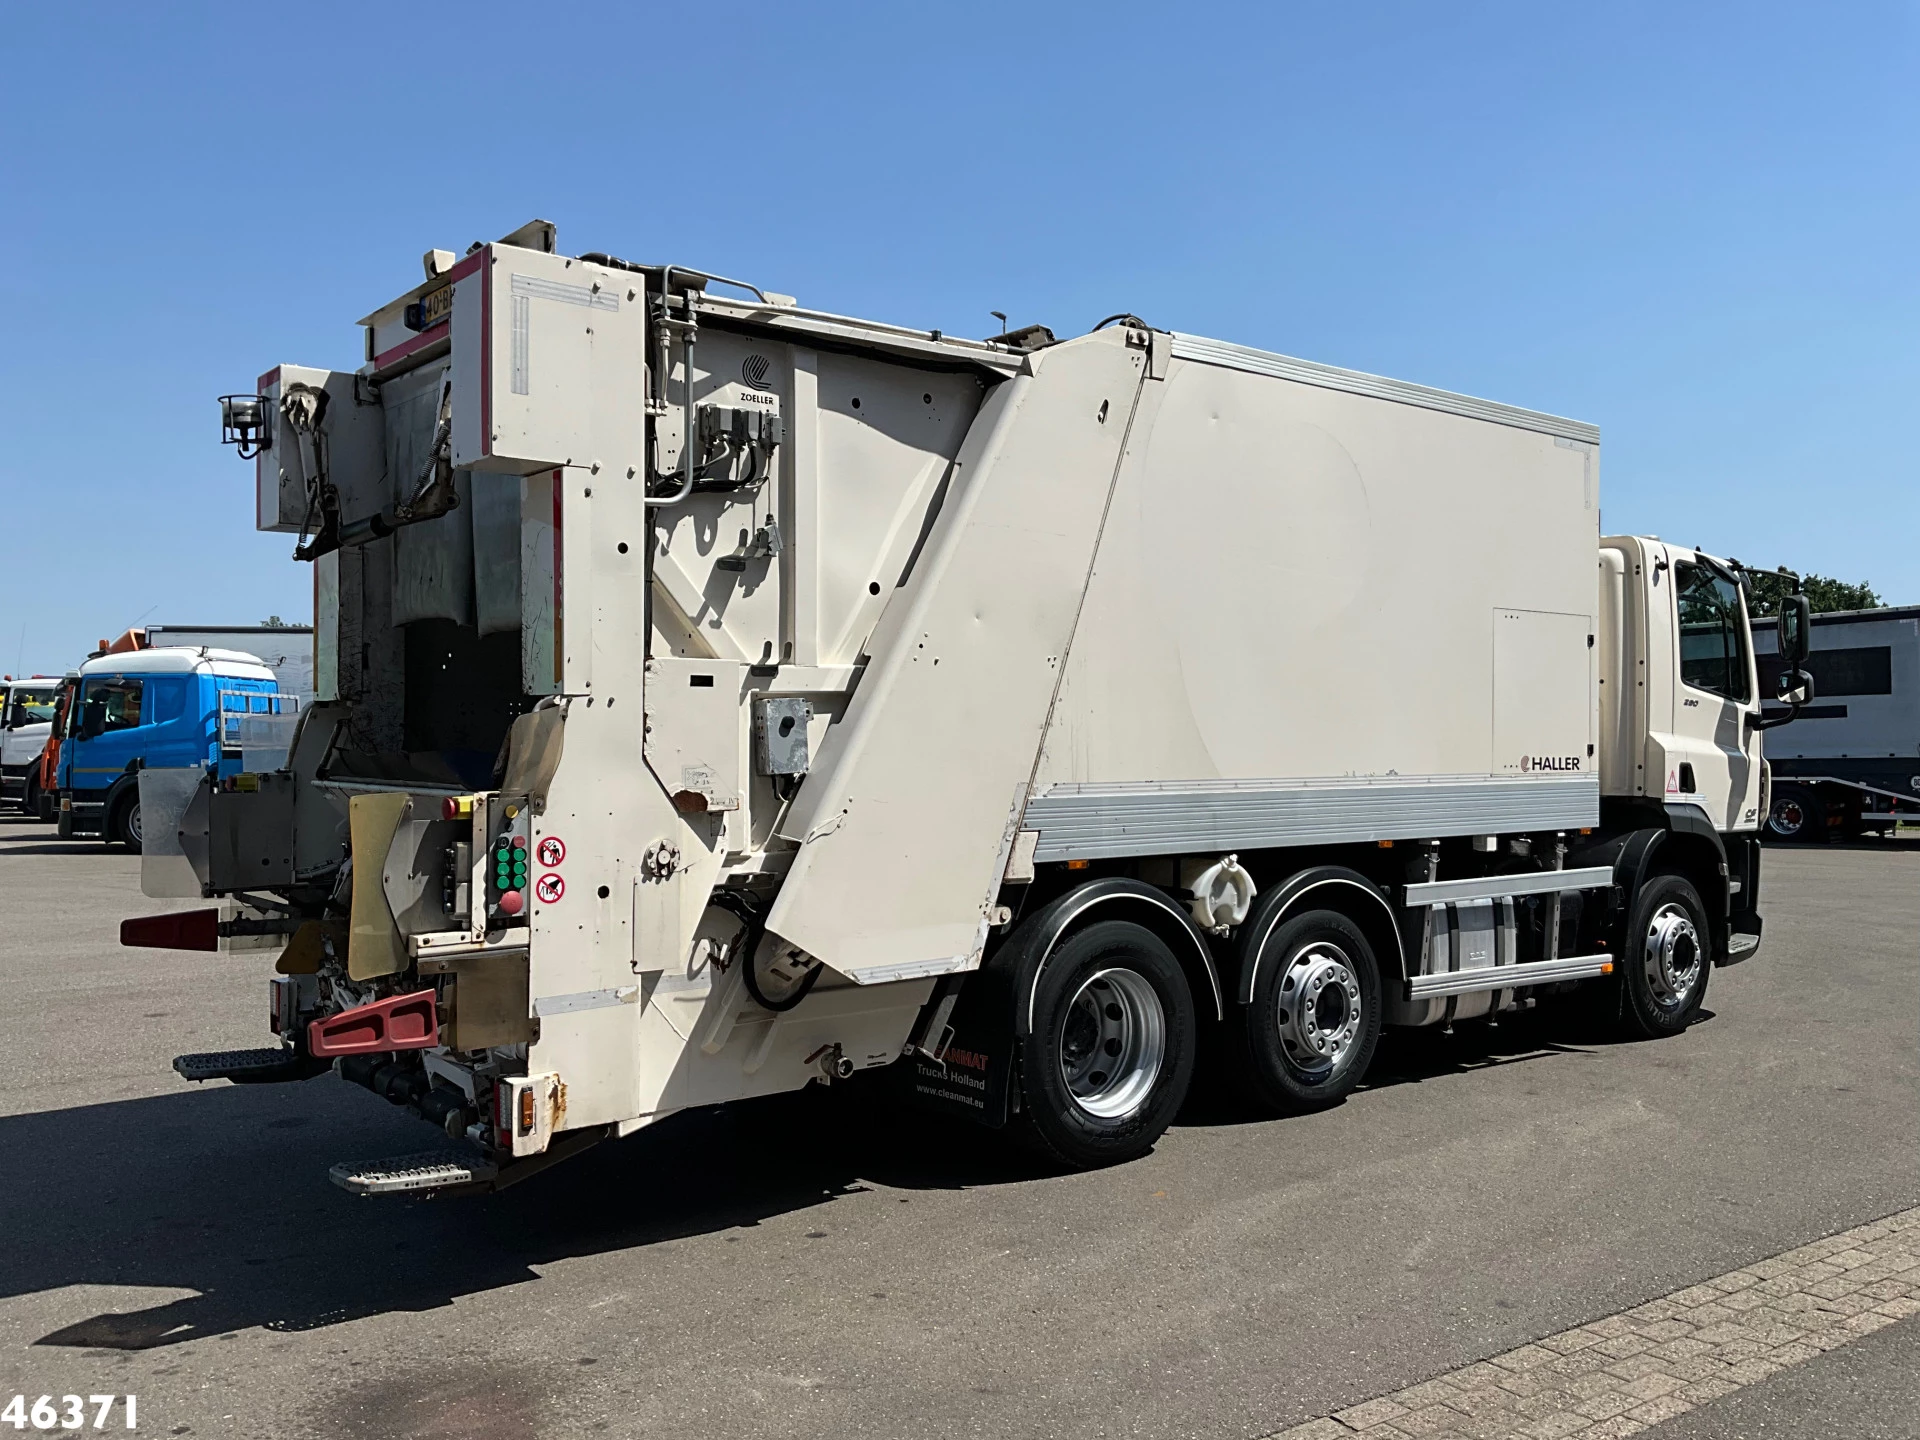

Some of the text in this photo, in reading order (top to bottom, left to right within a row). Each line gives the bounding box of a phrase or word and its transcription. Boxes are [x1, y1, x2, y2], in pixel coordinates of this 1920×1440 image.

[426, 289, 452, 317] 40-B
[740, 392, 774, 405] ZOELLER
[1532, 756, 1580, 771] HALLER
[916, 1063, 986, 1090] Trucks Holland
[916, 1084, 984, 1109] www.cleanmat.eu
